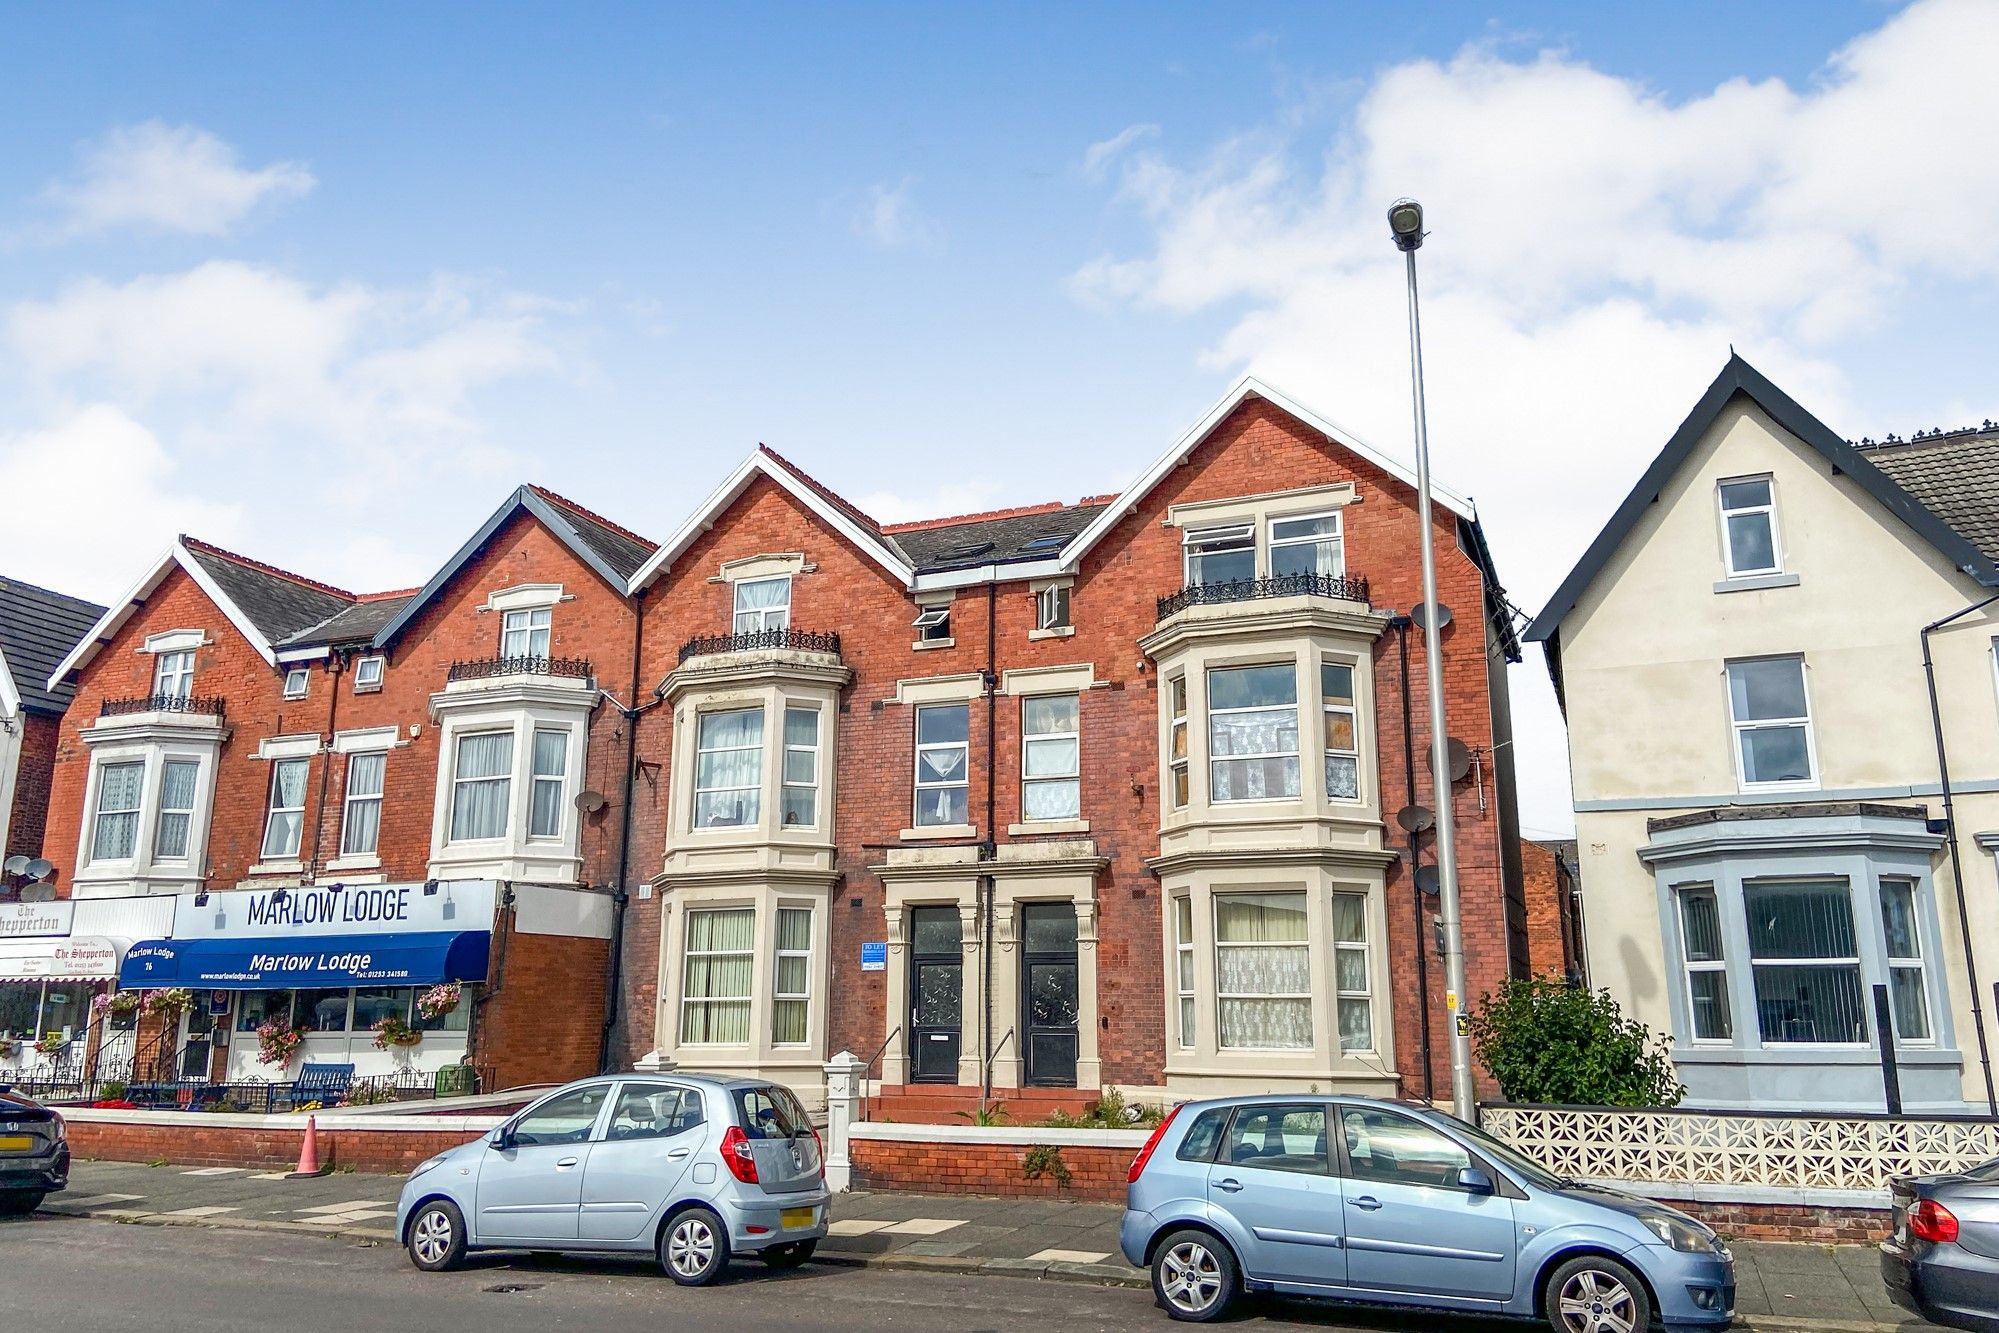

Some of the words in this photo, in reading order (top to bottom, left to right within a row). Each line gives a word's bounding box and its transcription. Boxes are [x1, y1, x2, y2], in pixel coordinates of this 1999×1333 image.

[17, 904, 35, 917] The
[248, 891, 338, 925] MARLOW
[343, 888, 409, 922] LODGE
[0, 917, 59, 934] hepperton
[55, 948, 69, 959] The
[71, 949, 114, 959] Shepperton
[128, 948, 152, 960] Marlow
[154, 946, 175, 959] Lodge
[145, 962, 153, 971] 76
[249, 954, 314, 971] Marlow
[317, 953, 371, 974] Lodge
[200, 972, 261, 980] www.marlowlodge.co.uk
[368, 970, 385, 978] 01253
